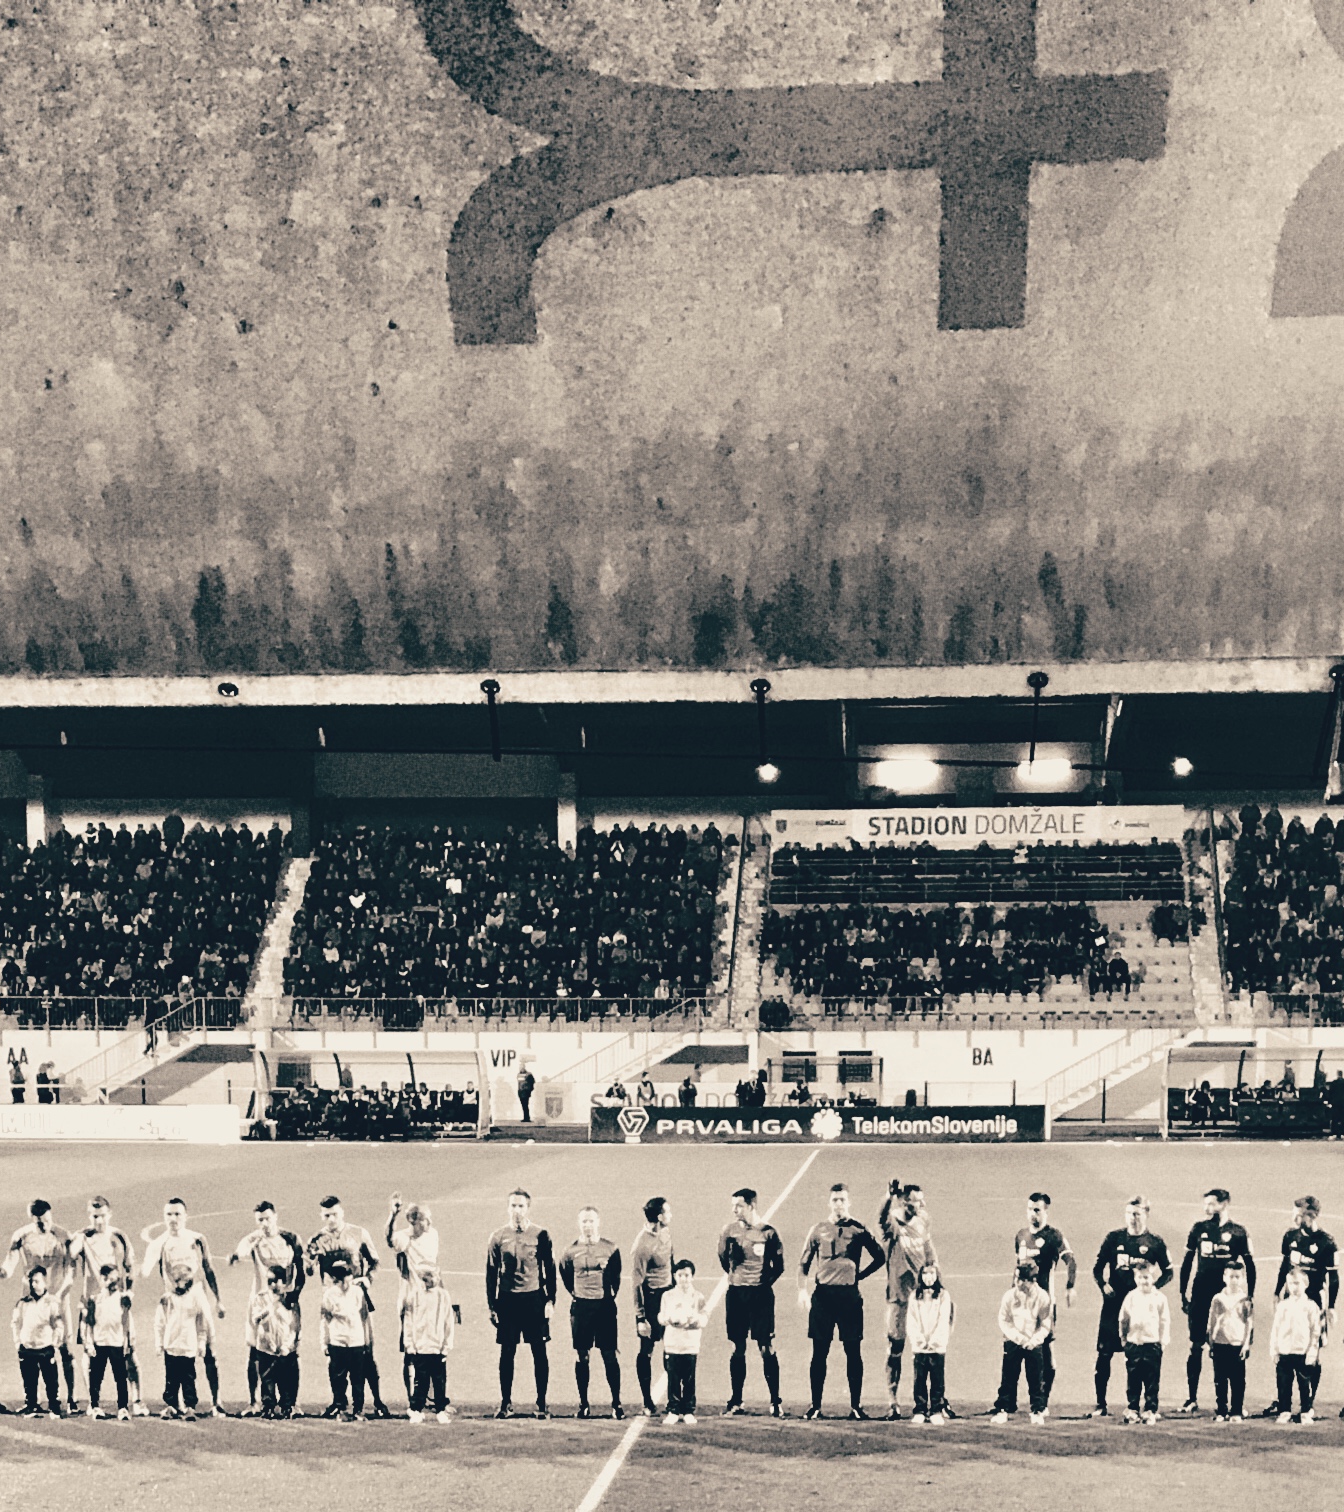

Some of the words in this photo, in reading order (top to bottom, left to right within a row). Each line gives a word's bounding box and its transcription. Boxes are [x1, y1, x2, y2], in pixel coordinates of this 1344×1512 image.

[868, 815, 967, 836] STADION
[975, 807, 1086, 835] DOMŽALE
[7, 1047, 29, 1065] AA
[490, 1049, 517, 1067] VIP
[972, 1047, 994, 1066] BA
[656, 1119, 803, 1135] PRVALIGA
[851, 1114, 1018, 1138] TelekomSlovenije
